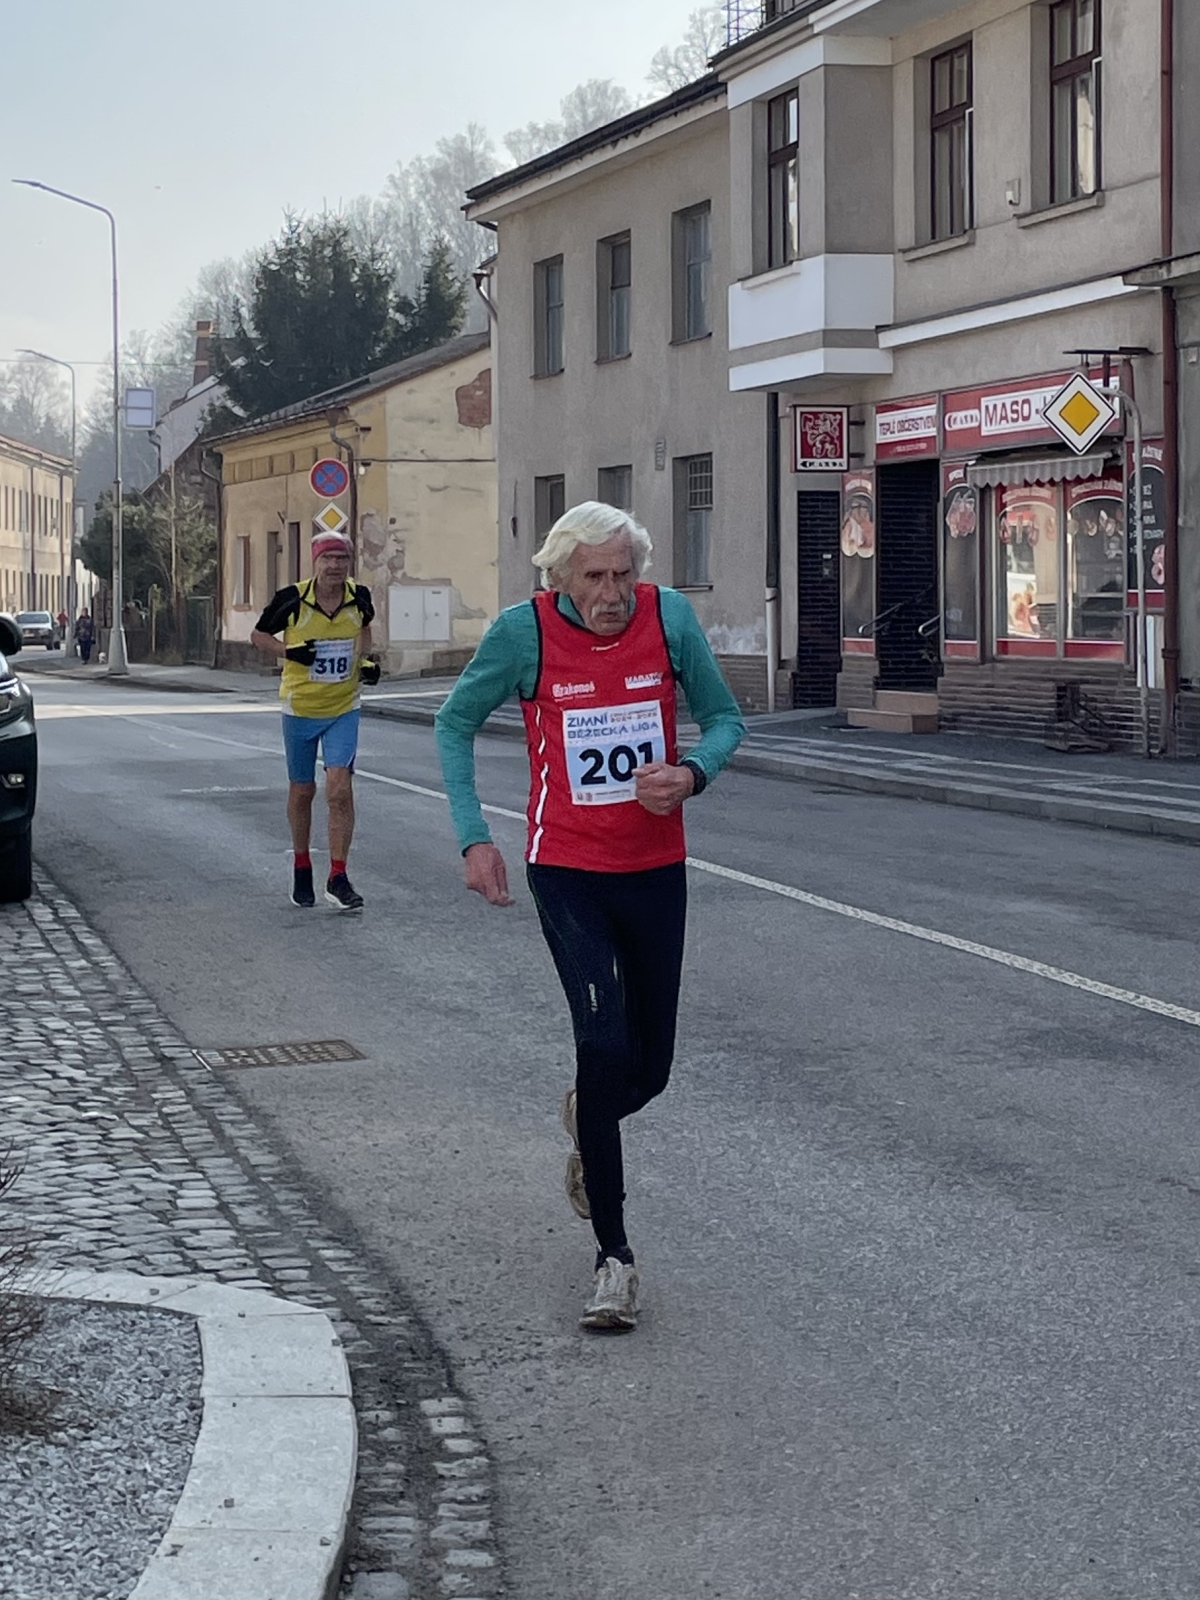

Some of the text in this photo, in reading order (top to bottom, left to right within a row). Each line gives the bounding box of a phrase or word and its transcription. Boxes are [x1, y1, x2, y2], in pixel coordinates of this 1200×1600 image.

[984, 398, 1031, 427] MASO
[315, 657, 347, 674] 318
[567, 712, 607, 727] ZIMNÍ
[632, 721, 659, 732] LIGA
[578, 741, 653, 785] 201
